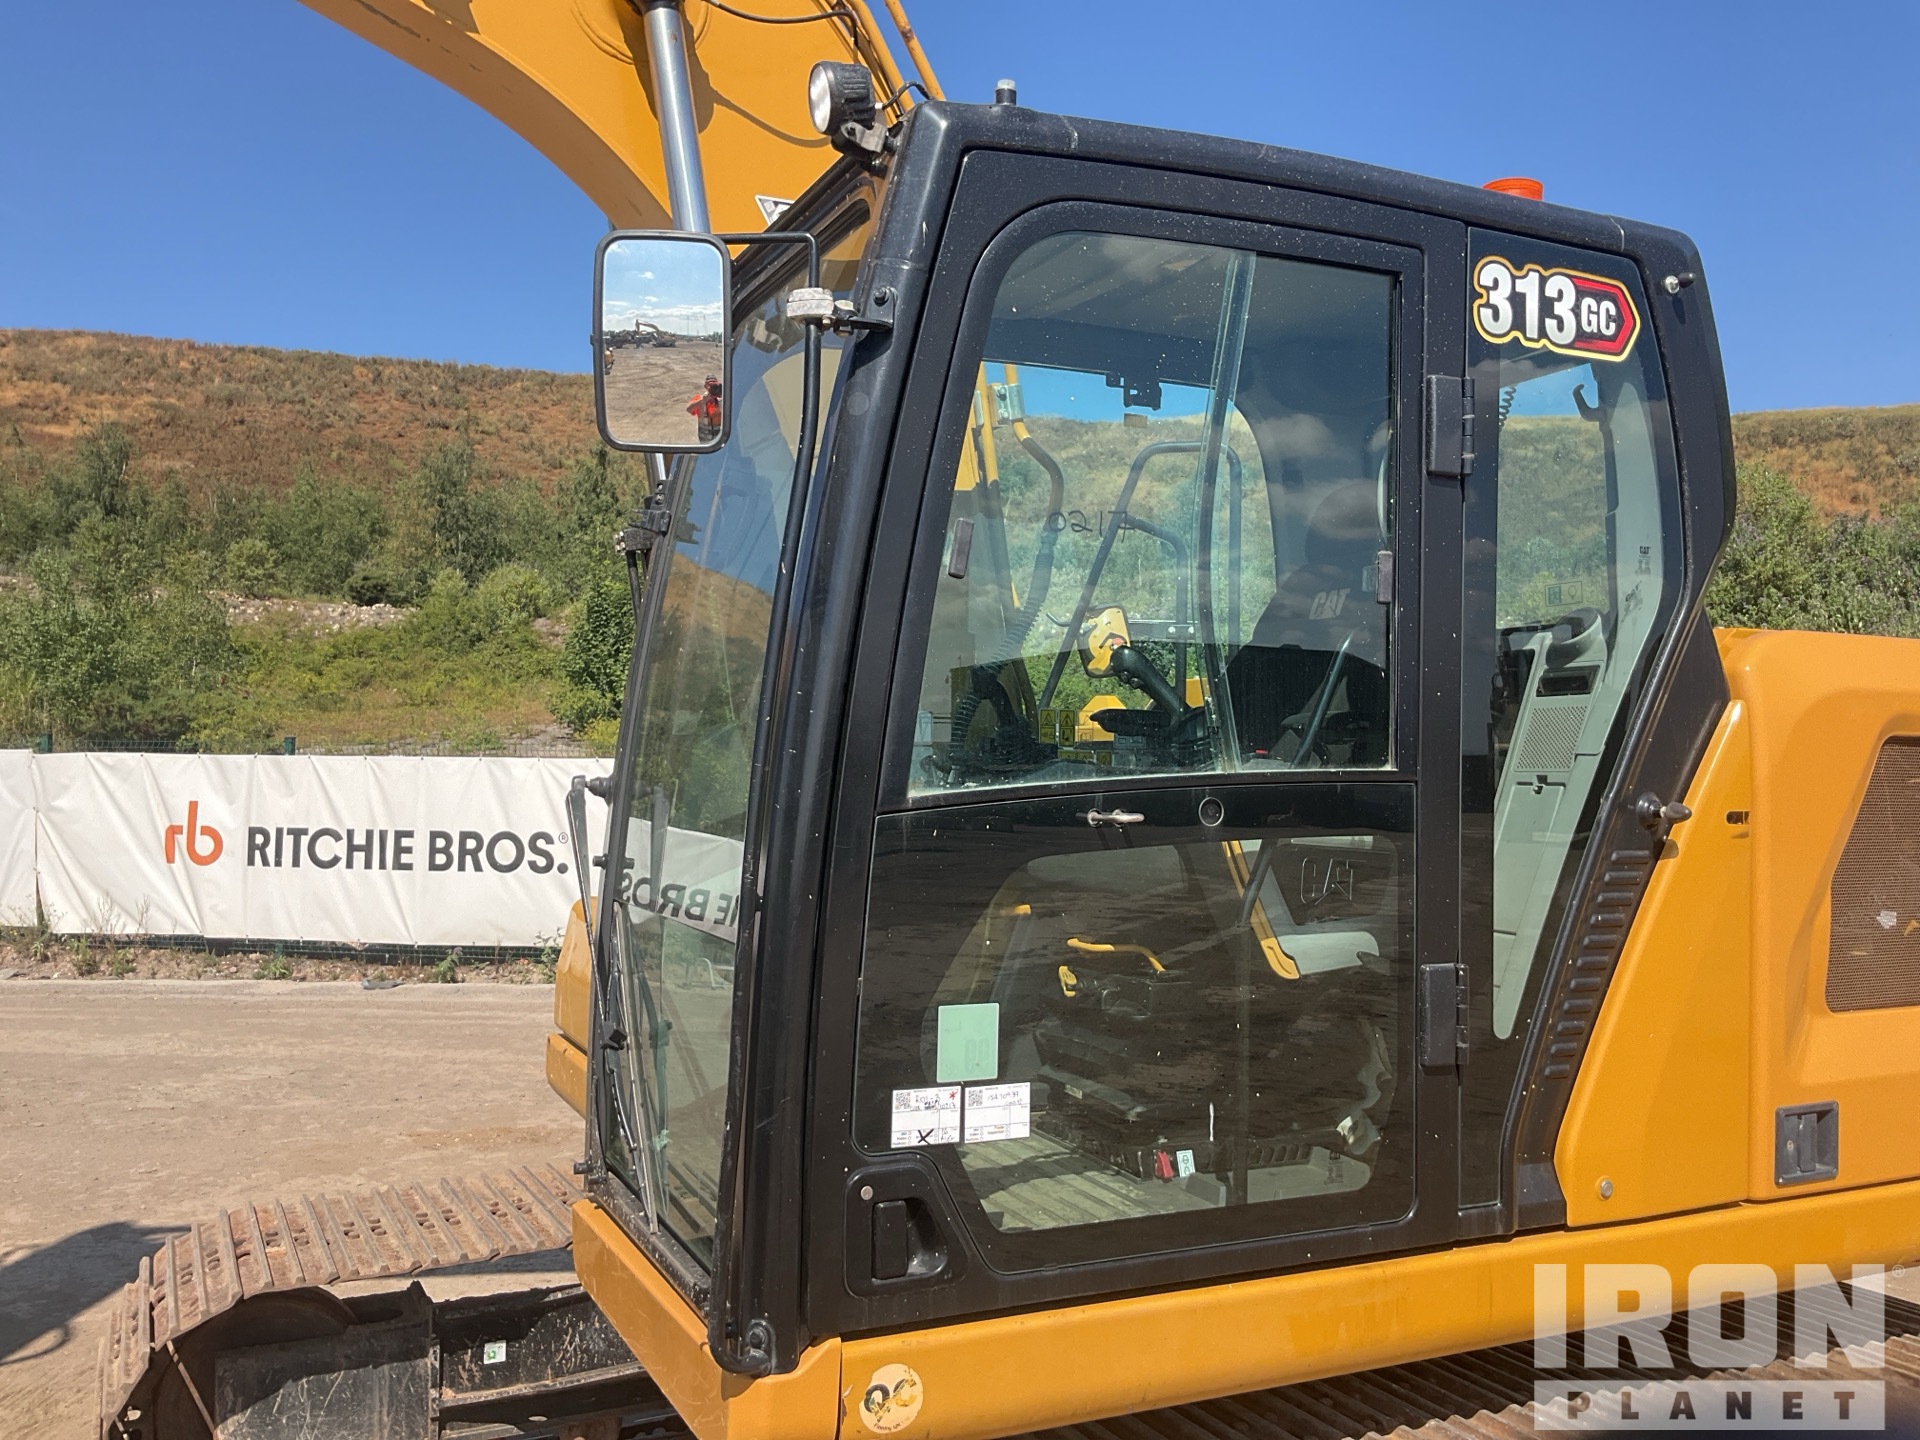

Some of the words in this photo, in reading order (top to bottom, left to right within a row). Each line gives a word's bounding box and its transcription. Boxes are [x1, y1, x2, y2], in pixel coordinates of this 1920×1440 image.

[1479, 263, 1576, 345] 313
[1580, 297, 1616, 336] GC
[1048, 510, 1135, 544] 0217
[1309, 588, 1351, 620] CAT
[164, 800, 224, 866] rb
[247, 826, 415, 871] RITCHIE
